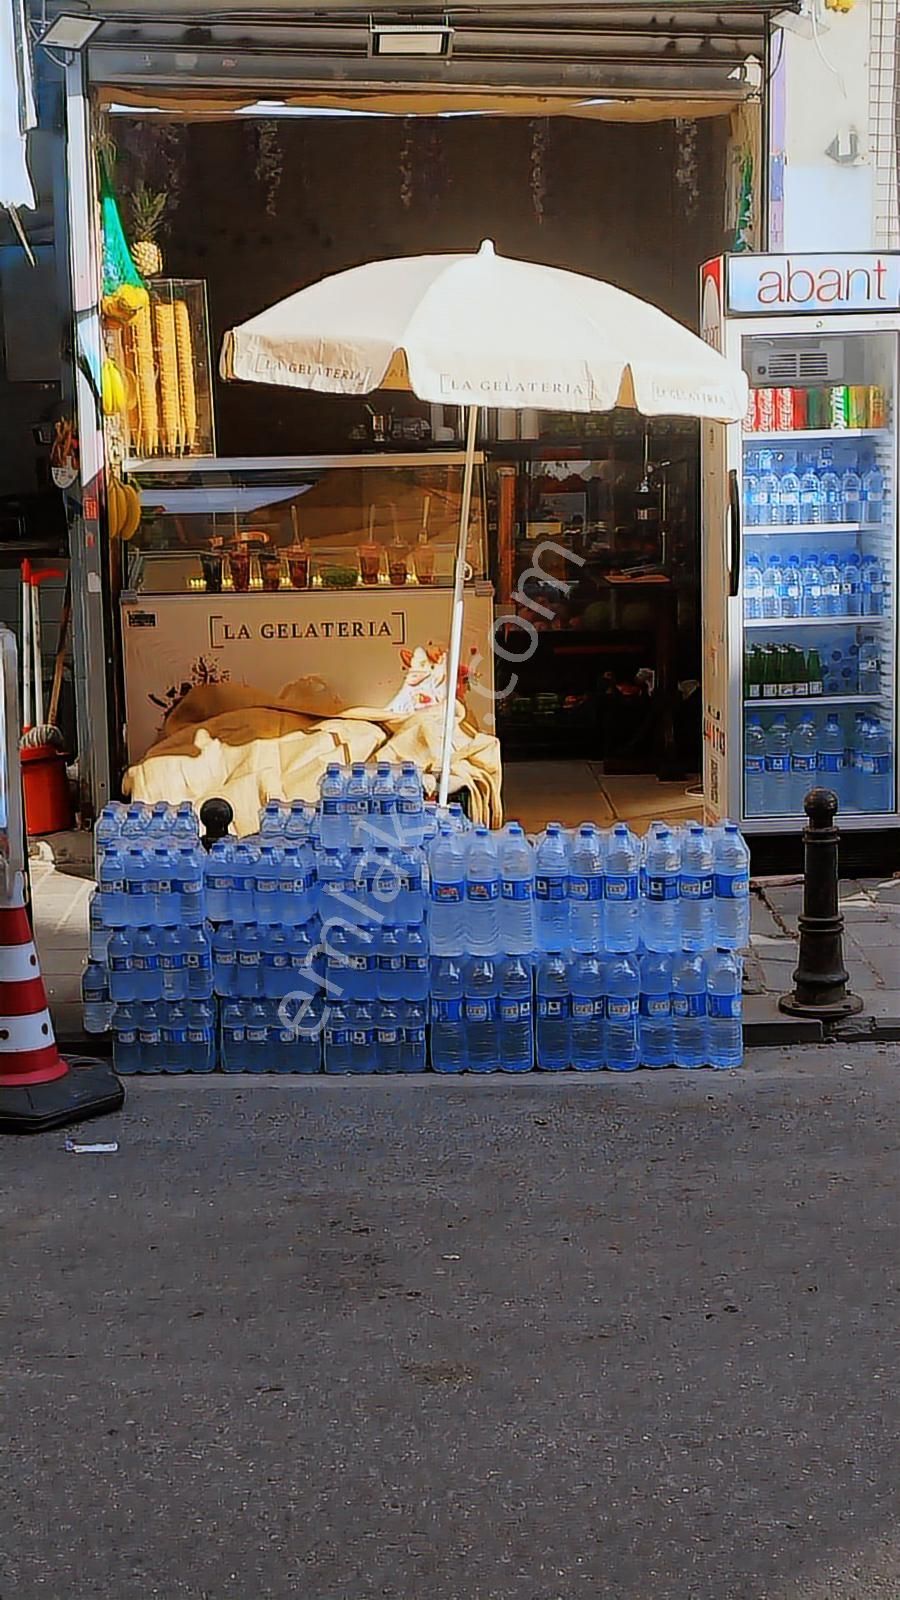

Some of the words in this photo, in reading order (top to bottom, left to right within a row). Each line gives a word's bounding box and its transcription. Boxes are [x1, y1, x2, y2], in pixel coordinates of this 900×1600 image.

[758, 259, 887, 303] abant
[451, 380, 472, 391] LA
[480, 381, 583, 395] GELATERIA
[223, 624, 250, 640] LA
[260, 621, 392, 638] GELATERIA
